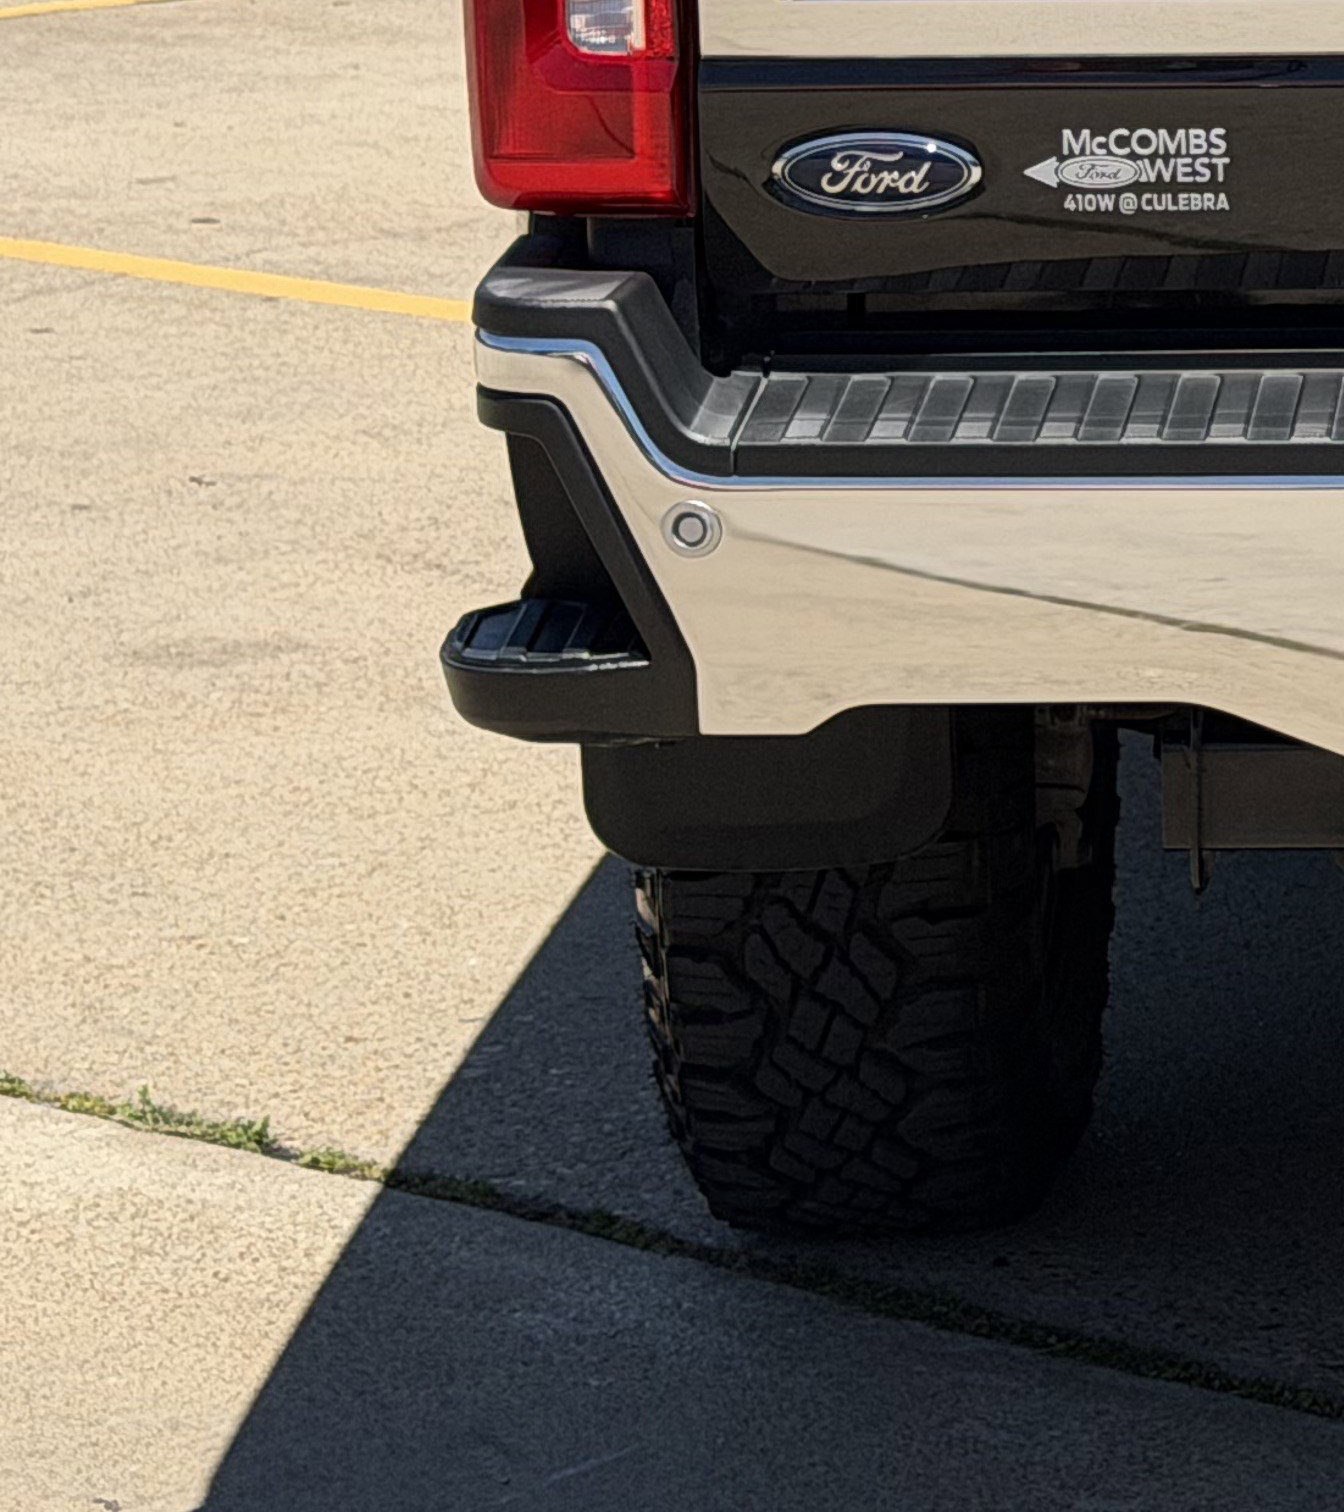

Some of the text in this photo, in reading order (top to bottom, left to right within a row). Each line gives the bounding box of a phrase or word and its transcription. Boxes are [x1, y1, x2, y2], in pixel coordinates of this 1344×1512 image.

[1062, 128, 1227, 156] McCOMBS
[820, 150, 930, 194] Ford
[1075, 157, 1231, 183] Ford WEST
[1063, 192, 1231, 215] 410W @ CULEBRA
